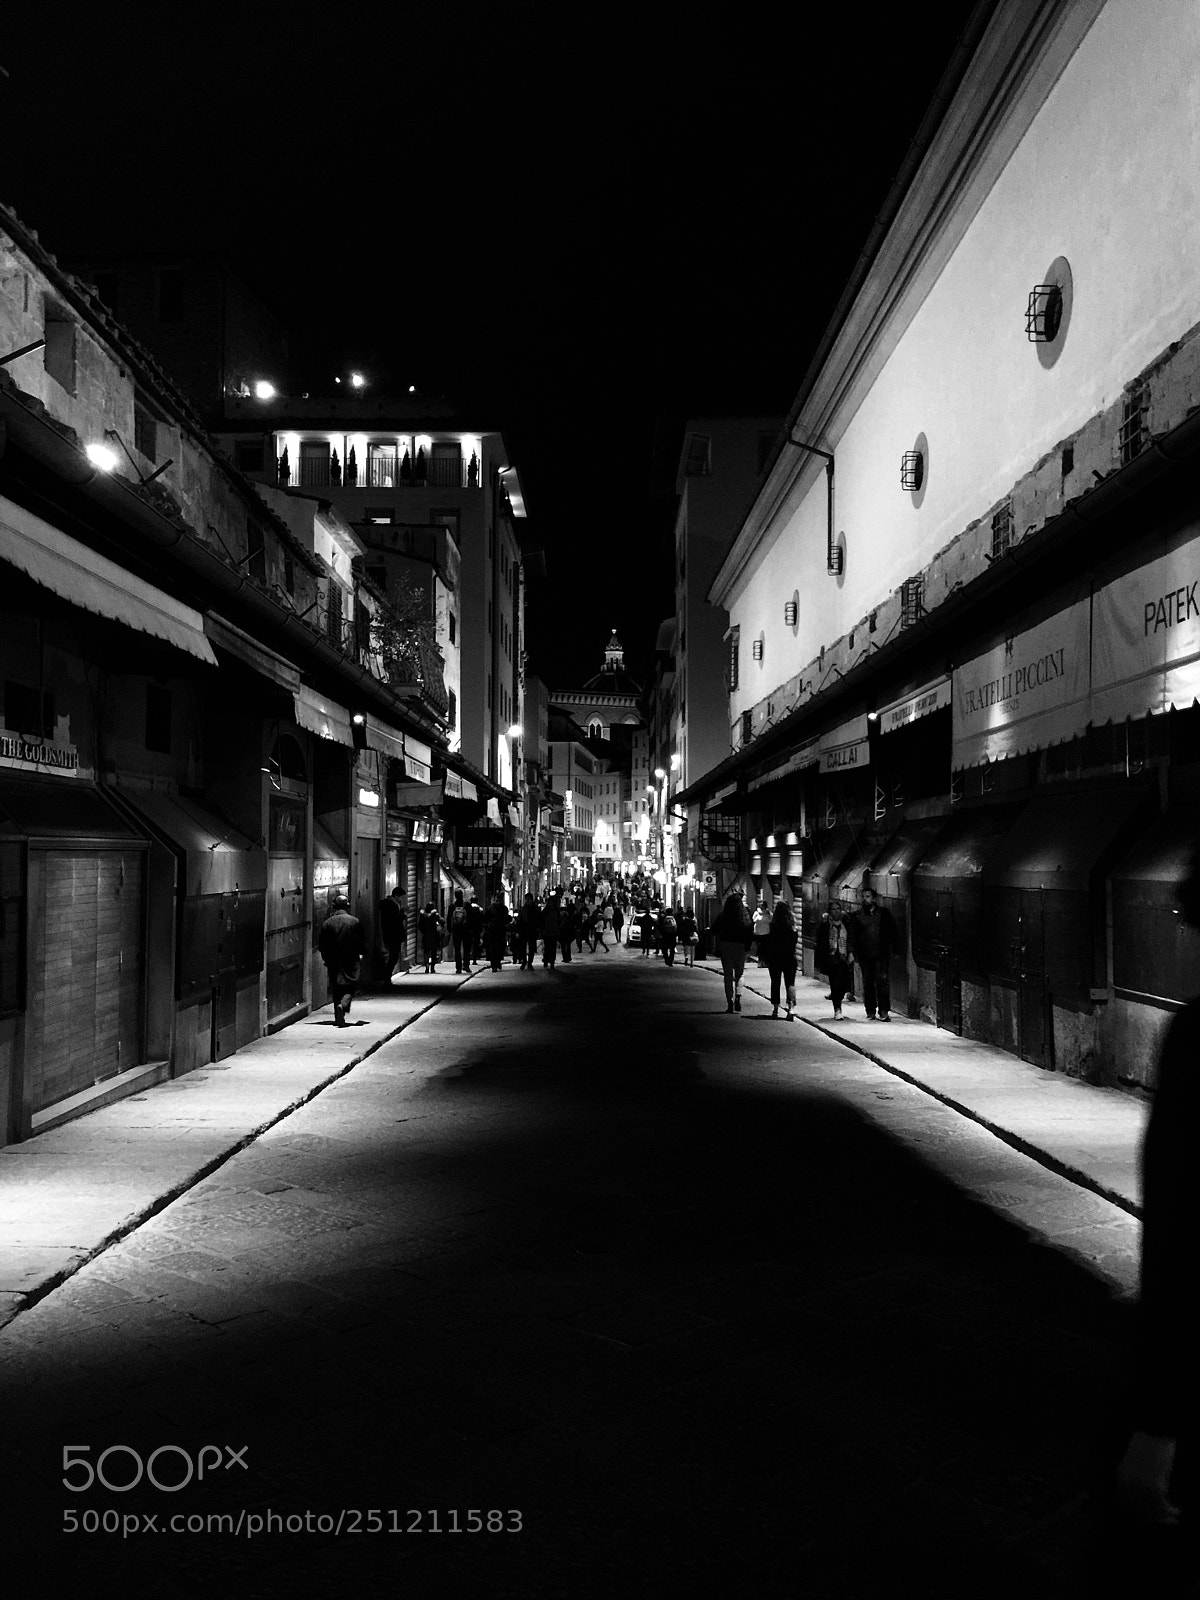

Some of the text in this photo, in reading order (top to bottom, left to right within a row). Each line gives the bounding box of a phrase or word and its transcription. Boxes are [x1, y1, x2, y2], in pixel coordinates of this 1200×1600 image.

[1144, 580, 1199, 637] PATEK
[965, 648, 1064, 714] FRATELLI PICCINI
[1, 736, 79, 768] THE GOLDSMITH
